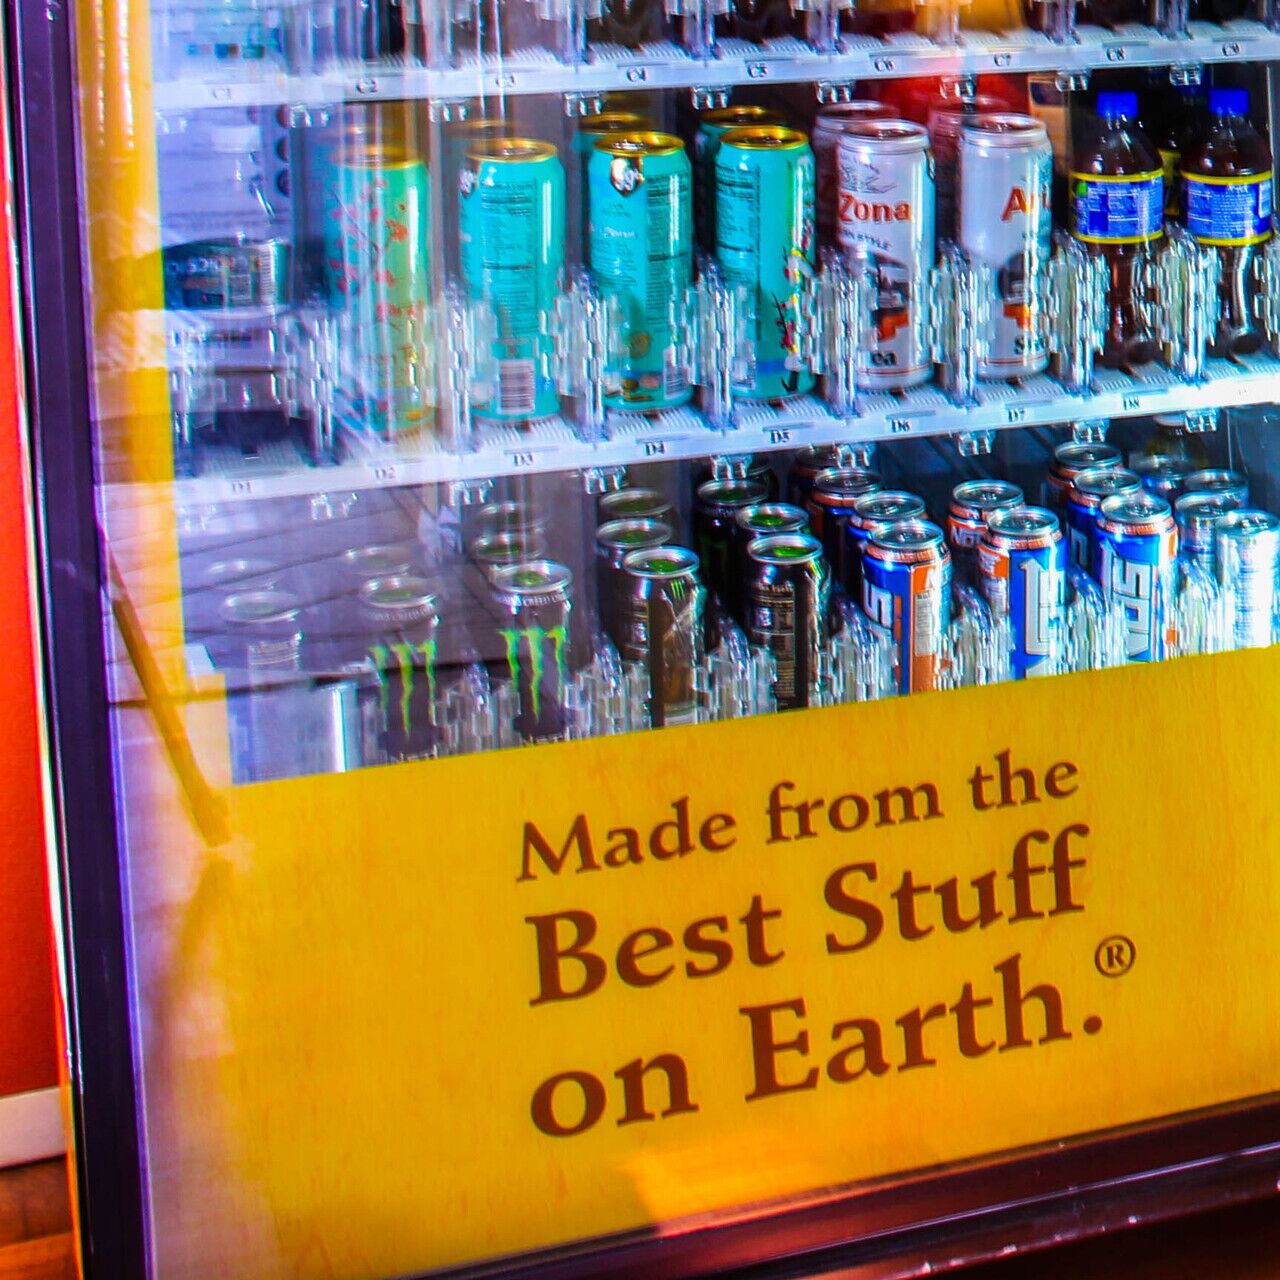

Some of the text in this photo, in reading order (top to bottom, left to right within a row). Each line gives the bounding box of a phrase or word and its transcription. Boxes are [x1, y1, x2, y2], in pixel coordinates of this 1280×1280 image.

[1107, 48, 1126, 63] C8
[1221, 42, 1241, 58] C9
[874, 57, 894, 73] C6
[993, 53, 1012, 68] C7
[626, 67, 648, 83] C4
[746, 63, 769, 79] C5
[1123, 395, 1141, 411] D8
[1007, 407, 1026, 423] D7
[891, 418, 911, 433] D6
[770, 428, 791, 445] D5
[645, 440, 667, 456] D4
[514, 451, 535, 467] D3
[515, 749, 1079, 882] Made from the
[524, 822, 1089, 1008] Best Stuff
[530, 1048, 699, 1139] on
